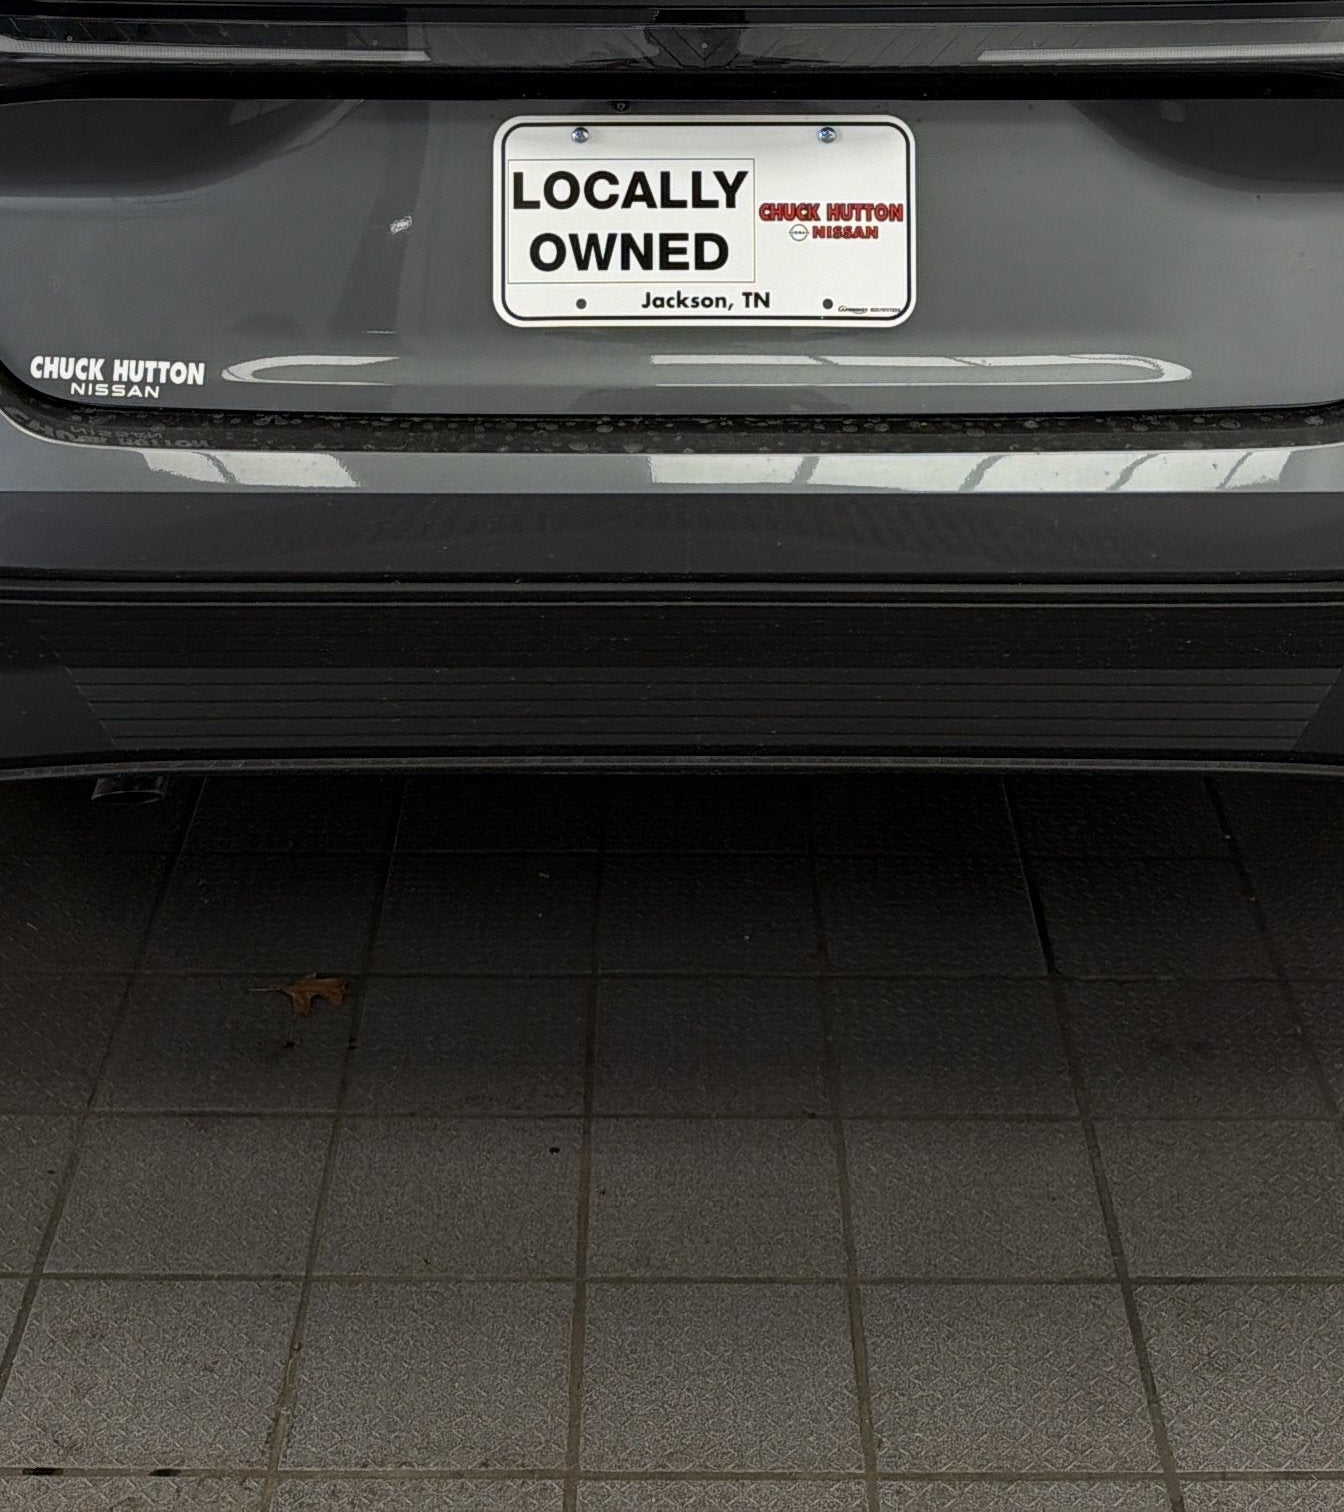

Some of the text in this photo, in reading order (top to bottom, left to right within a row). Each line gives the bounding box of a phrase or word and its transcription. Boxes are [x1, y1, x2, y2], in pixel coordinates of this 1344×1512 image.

[512, 170, 749, 210] LOCALLY
[759, 202, 904, 223] CHUCK HUTTON
[812, 225, 879, 240] NISSAN
[529, 232, 729, 272] OWNED
[641, 290, 770, 311] Jackson, TN
[30, 355, 205, 386] CHUCK HUTTON
[70, 382, 160, 399] NISSAN
